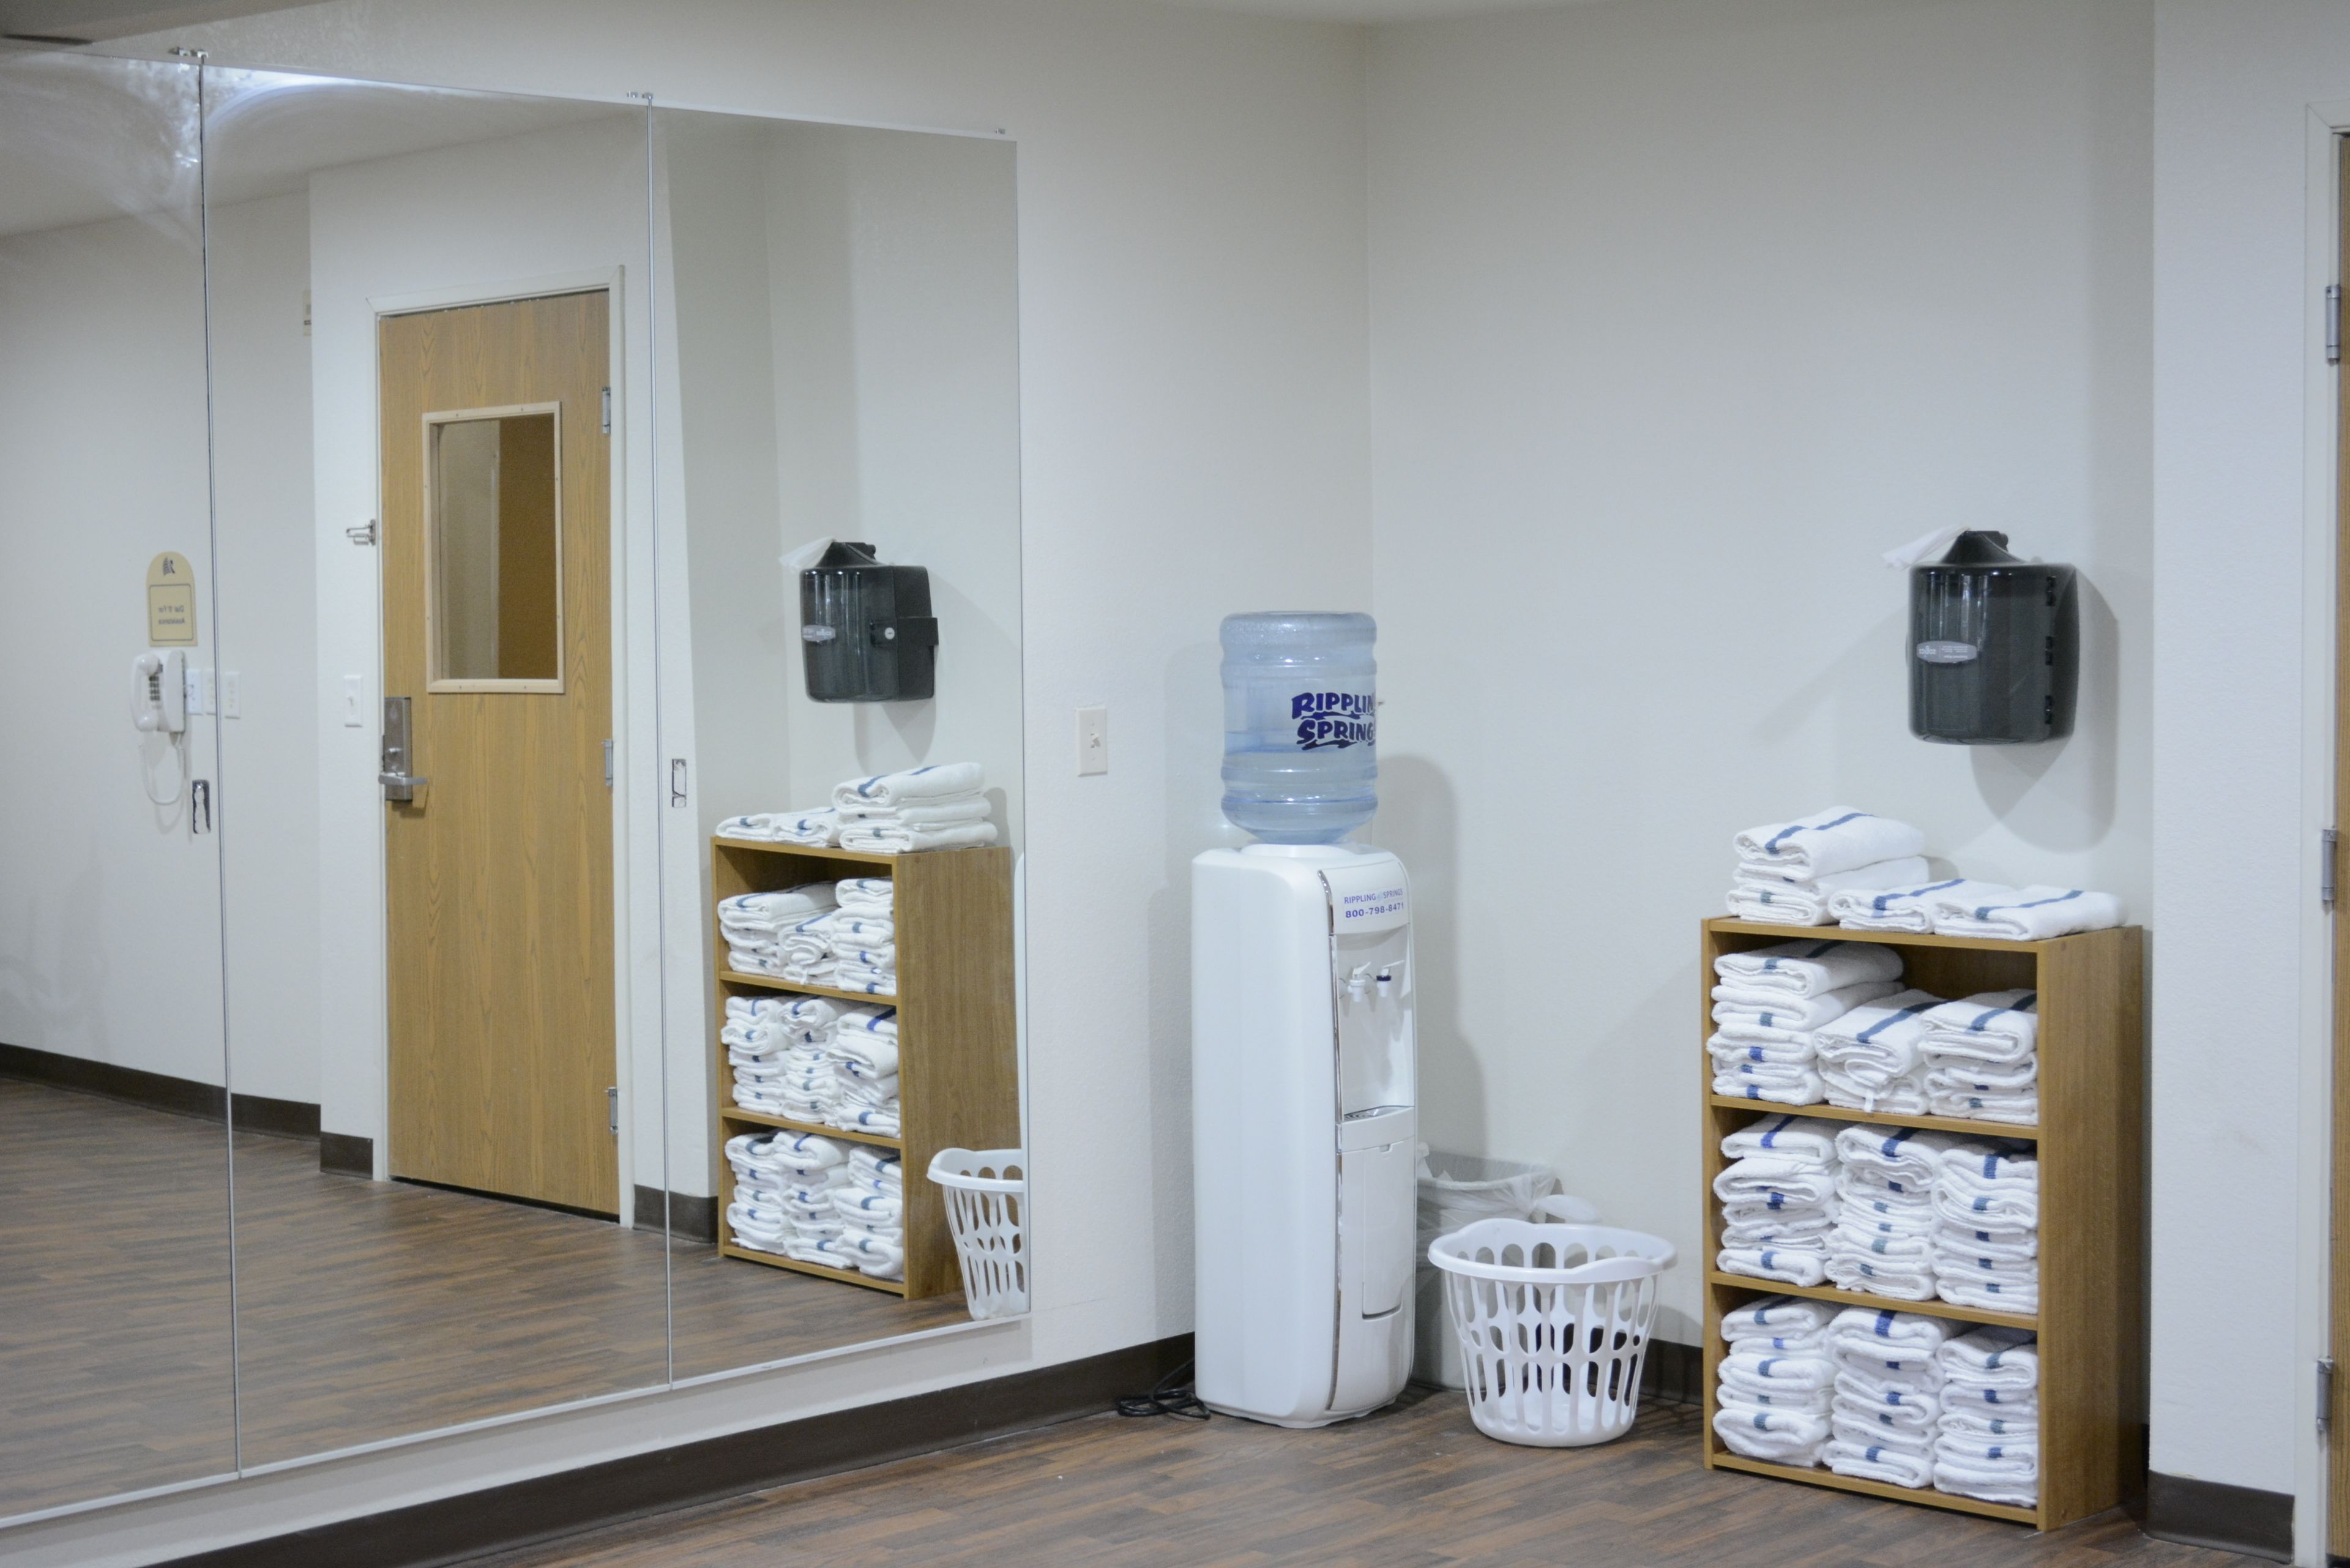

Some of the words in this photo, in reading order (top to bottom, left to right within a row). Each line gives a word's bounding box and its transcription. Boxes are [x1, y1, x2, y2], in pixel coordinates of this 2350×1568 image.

[1291, 692, 1375, 719] RIPPLIN
[1297, 719, 1375, 745] SPRING
[1344, 893, 1376, 904] RIPPLING
[1383, 888, 1403, 899] SPRINGS
[1345, 902, 1404, 918] 800-798-8471
